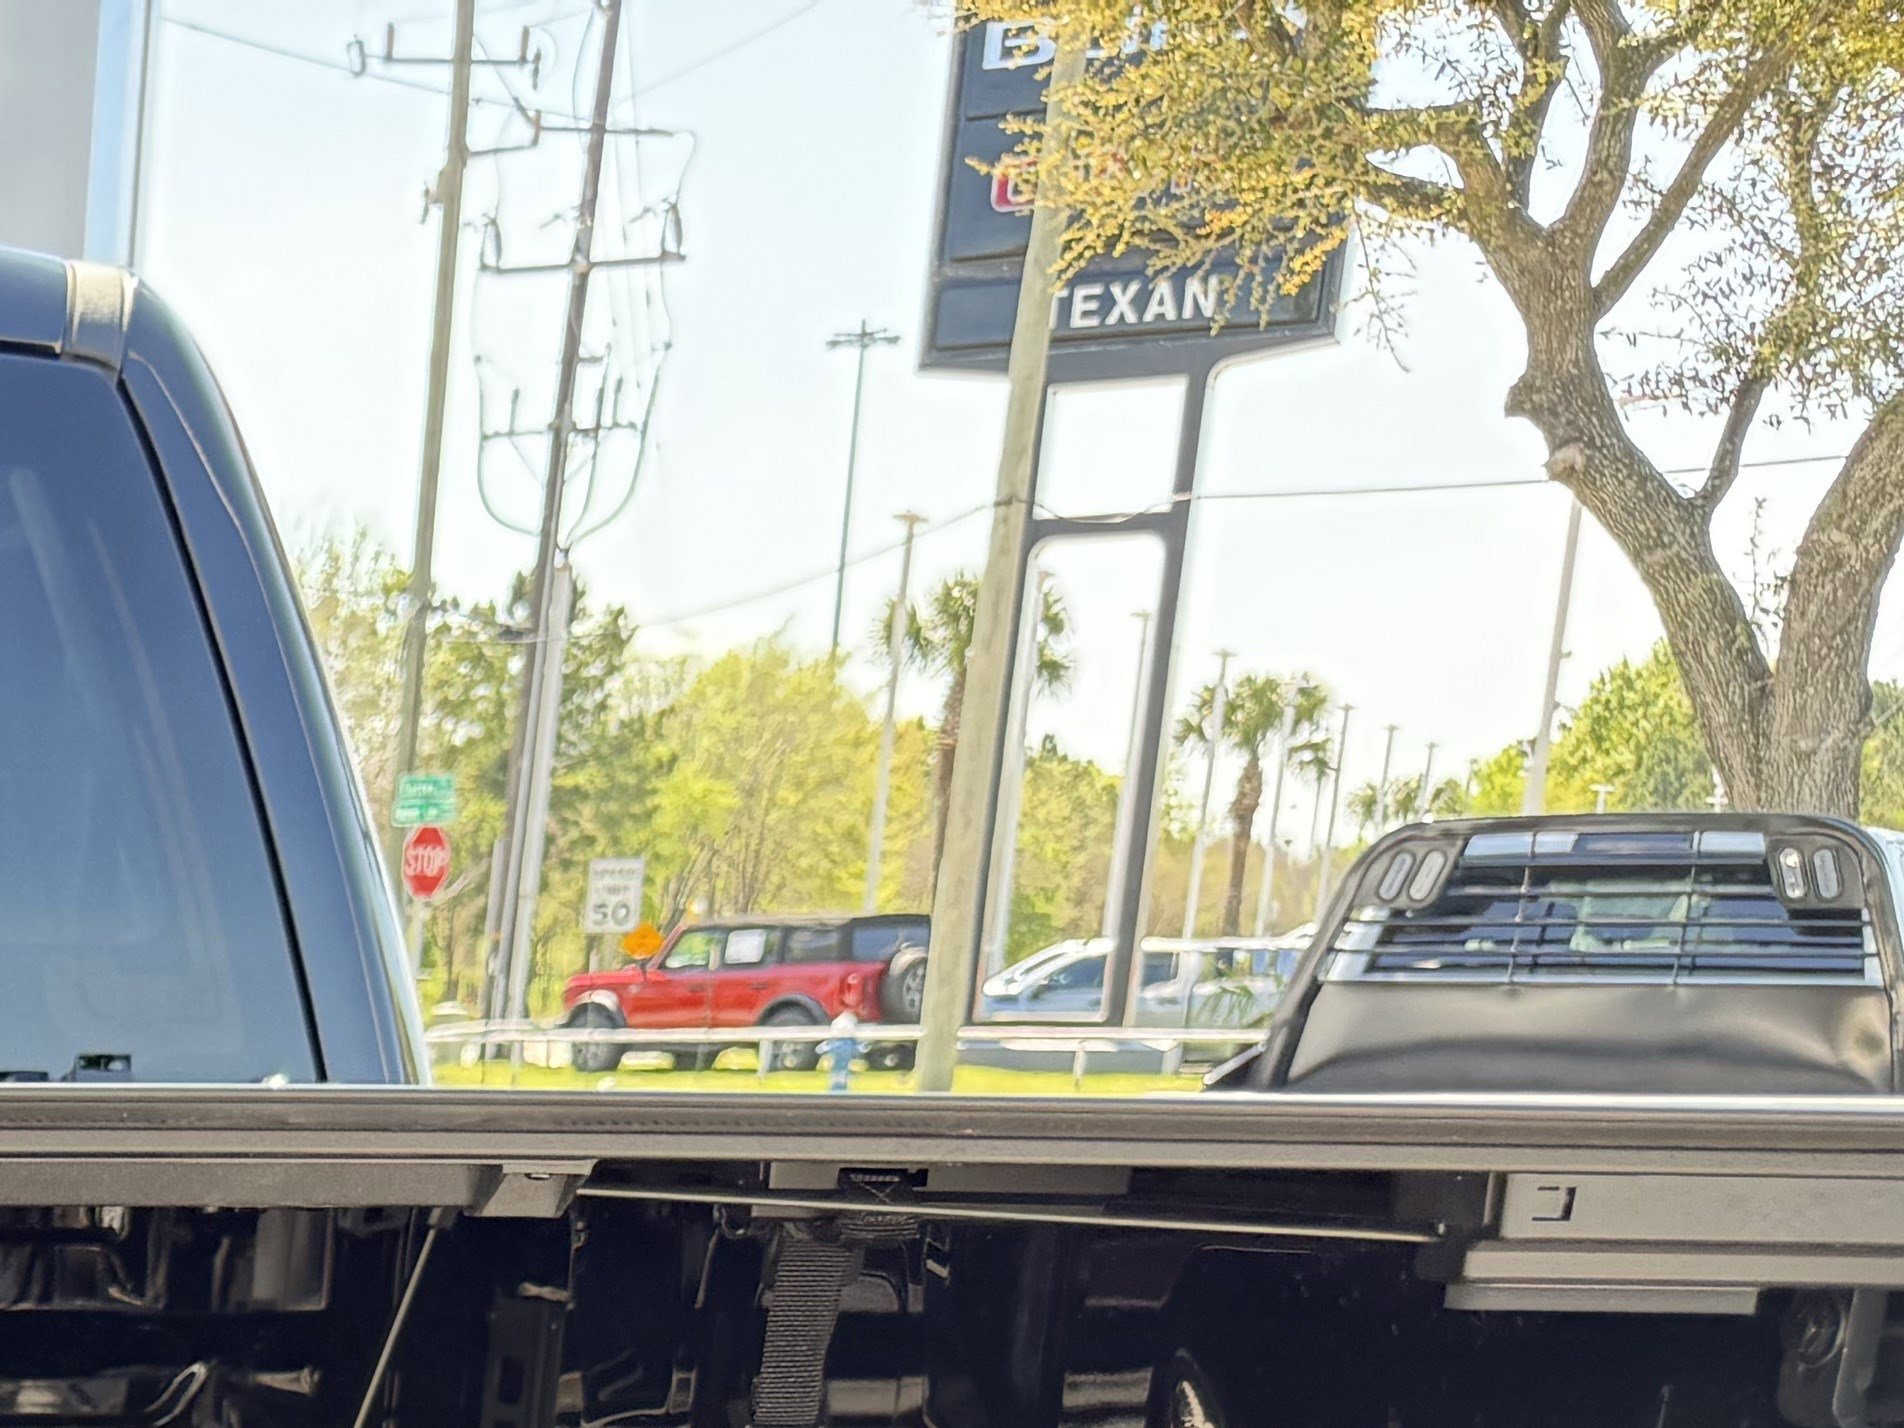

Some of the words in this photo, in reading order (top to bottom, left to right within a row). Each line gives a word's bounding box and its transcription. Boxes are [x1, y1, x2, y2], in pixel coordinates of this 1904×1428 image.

[1049, 275, 1219, 328] TEXAN
[404, 844, 449, 878] STOP
[593, 902, 631, 927] 50
